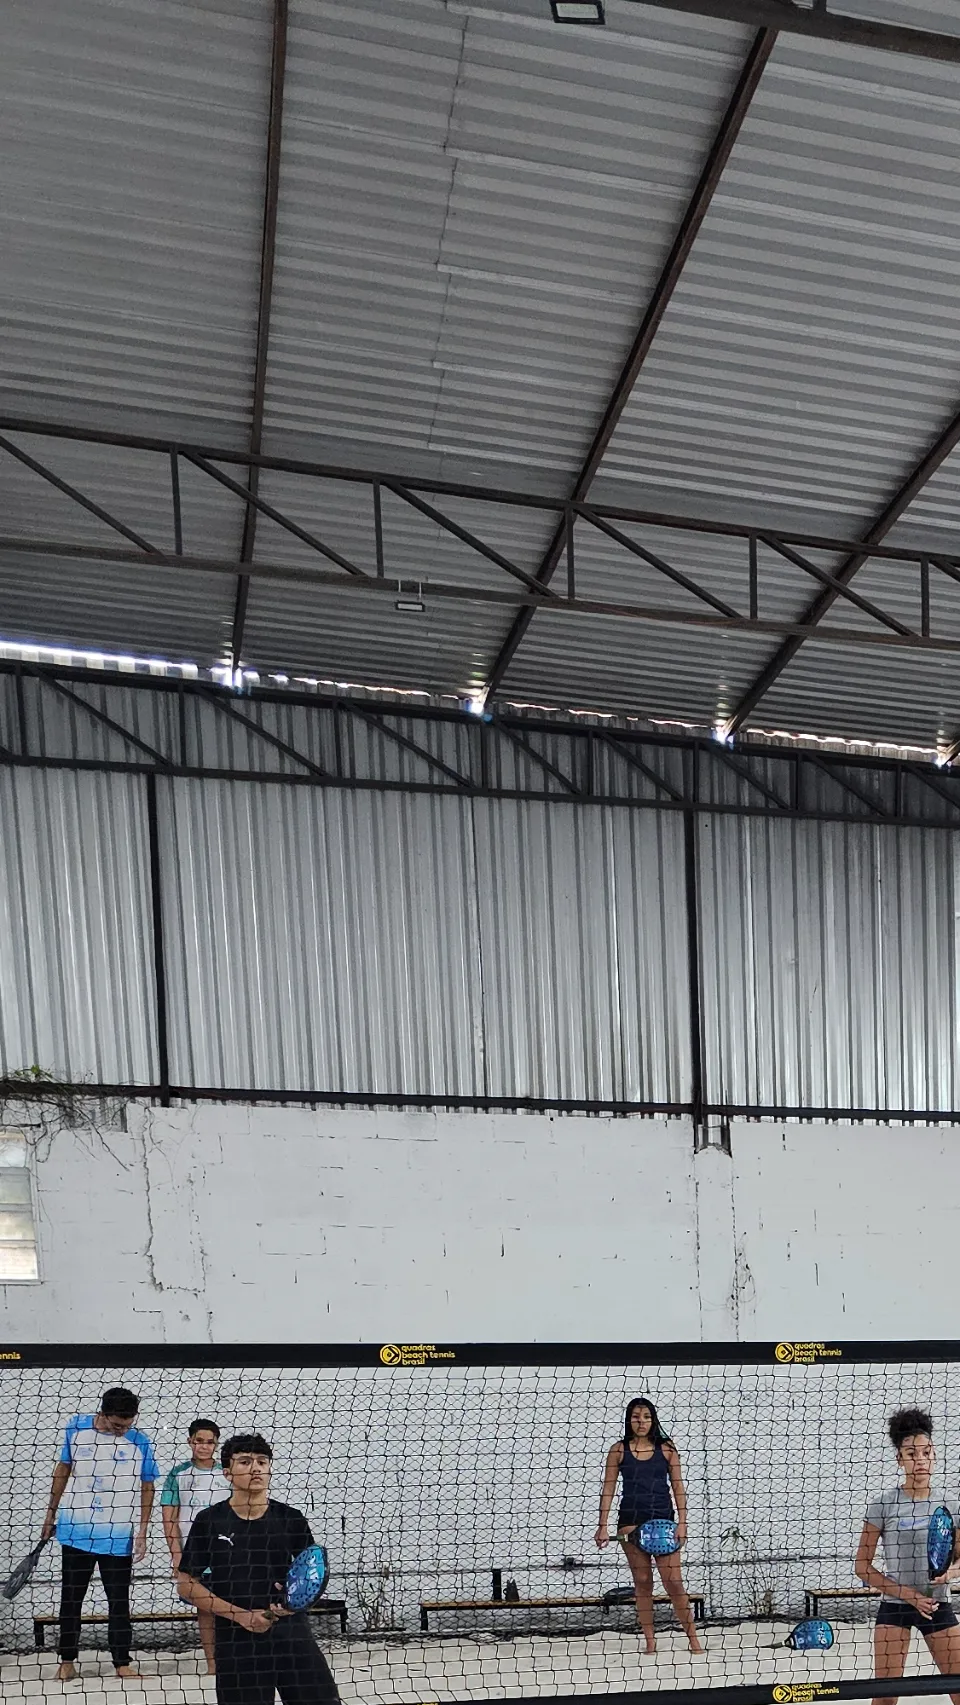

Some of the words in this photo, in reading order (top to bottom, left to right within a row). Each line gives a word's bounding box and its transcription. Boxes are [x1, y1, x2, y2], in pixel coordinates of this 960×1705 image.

[401, 1344, 436, 1352] quadras
[794, 1342, 825, 1350] quadras
[0, 1352, 21, 1360] ennis
